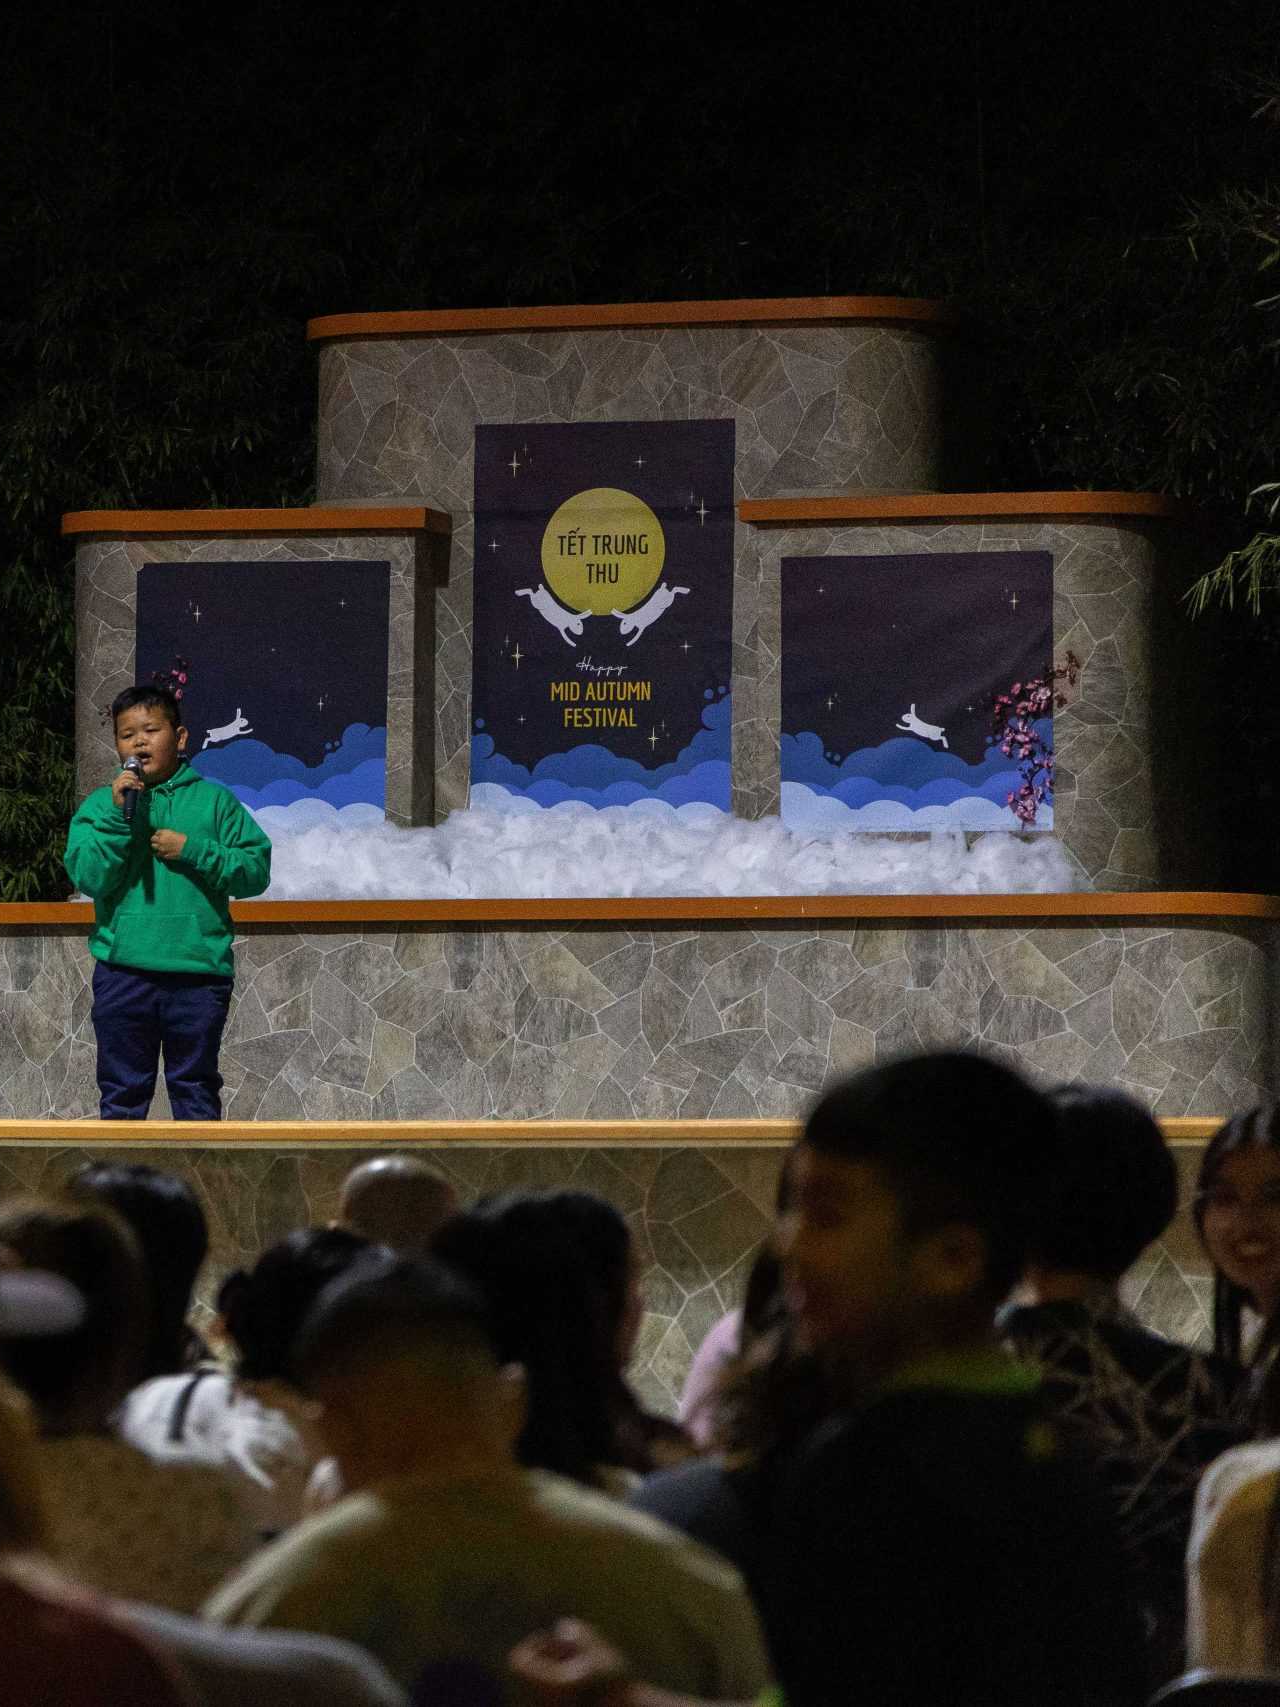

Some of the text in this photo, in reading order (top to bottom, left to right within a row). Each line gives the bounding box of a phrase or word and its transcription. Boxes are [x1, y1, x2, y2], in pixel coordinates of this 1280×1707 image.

[557, 528, 648, 556] TẾT TRUNG
[587, 563, 618, 584] THU
[576, 656, 627, 677] Happy
[551, 681, 651, 702] MID AUTUMN
[564, 708, 637, 729] FESTIVAL
